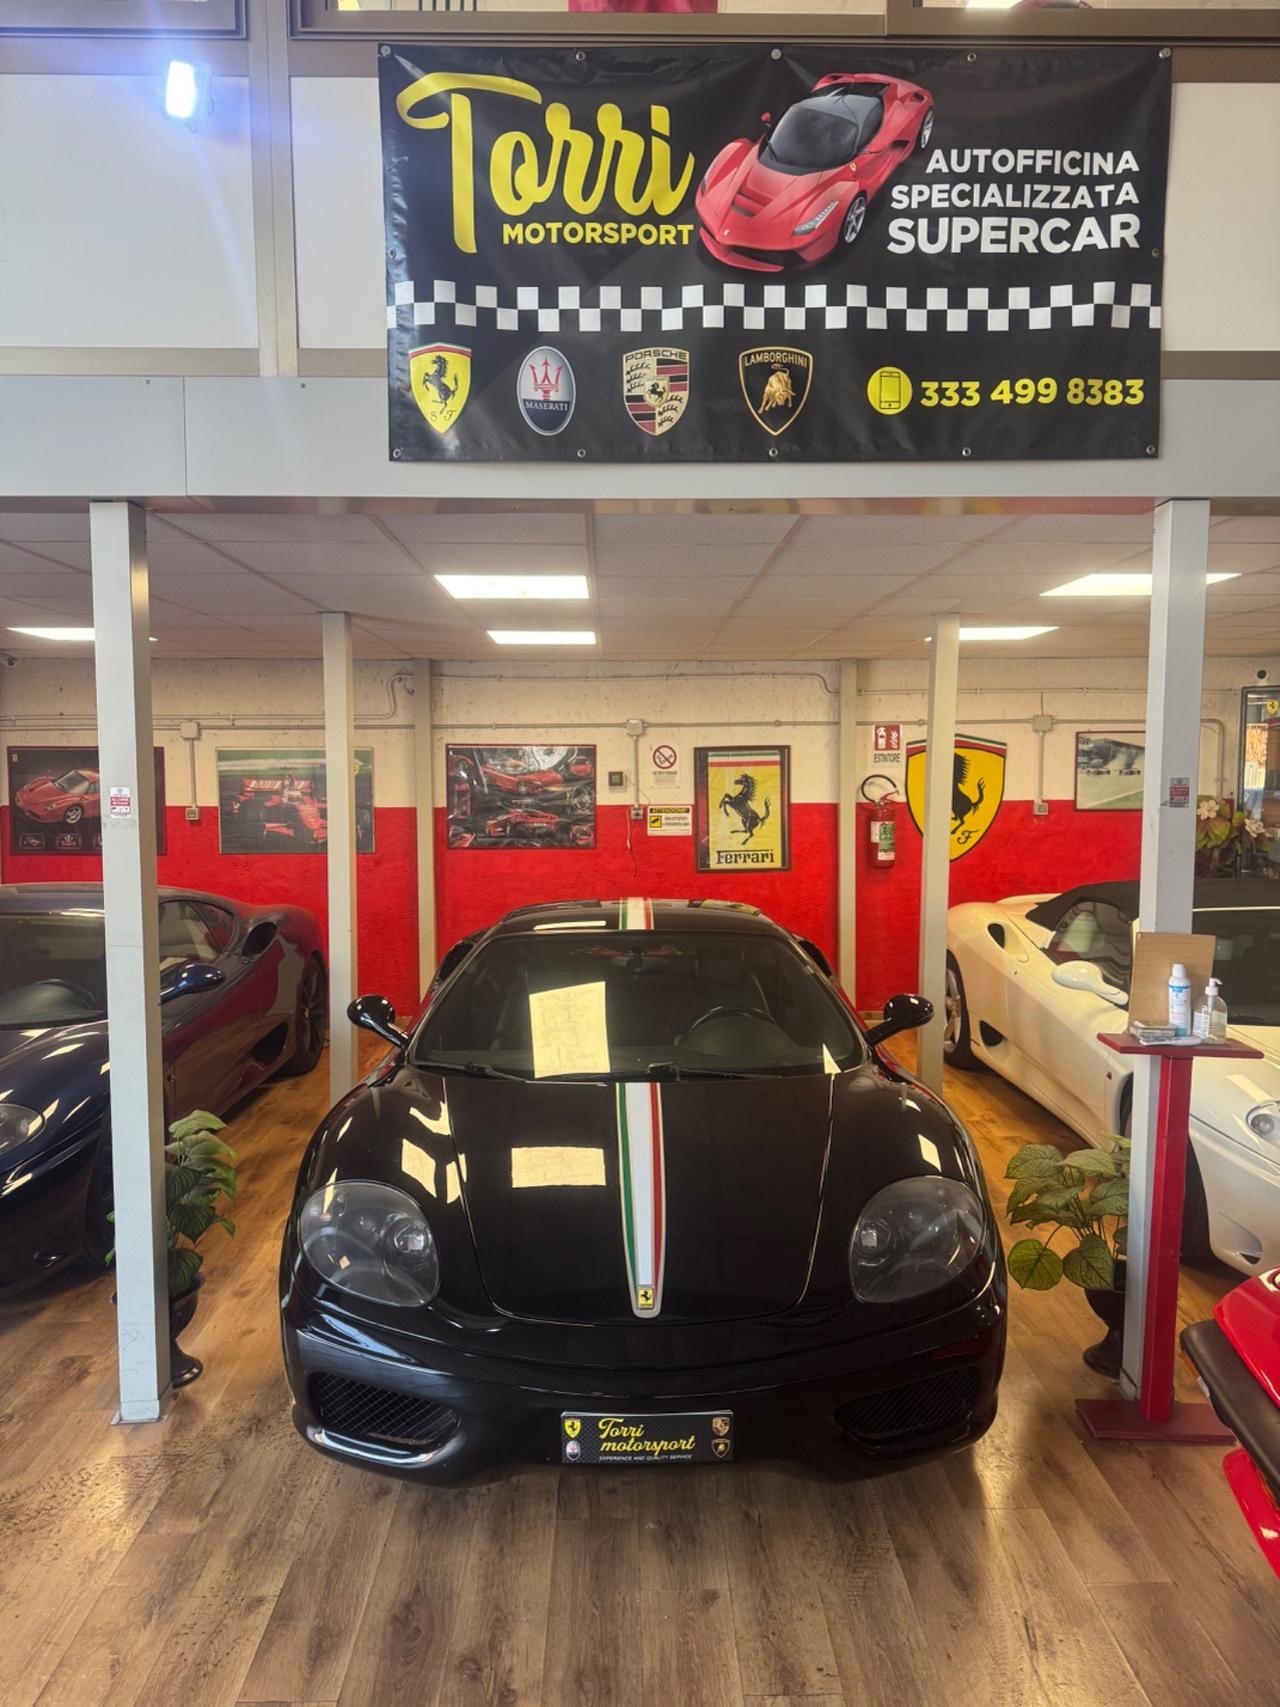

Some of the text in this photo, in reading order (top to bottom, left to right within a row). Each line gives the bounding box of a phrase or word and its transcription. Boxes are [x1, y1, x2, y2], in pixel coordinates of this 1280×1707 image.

[396, 71, 696, 253] Torri
[925, 148, 1141, 176] AUTOFFICINA
[890, 181, 1140, 210] SPECIALIZZATA
[502, 221, 695, 246] MOTORSPORT
[886, 212, 1142, 255] SUPERCAR
[624, 348, 688, 363] PORSCHE
[744, 351, 808, 368] LAMBORGHINI
[920, 376, 1145, 407] 333 499 8383
[525, 401, 569, 411] MASERATI
[715, 848, 776, 864] Ferrari
[598, 1417, 645, 1439] Torri
[600, 1435, 697, 1456] motorsport
